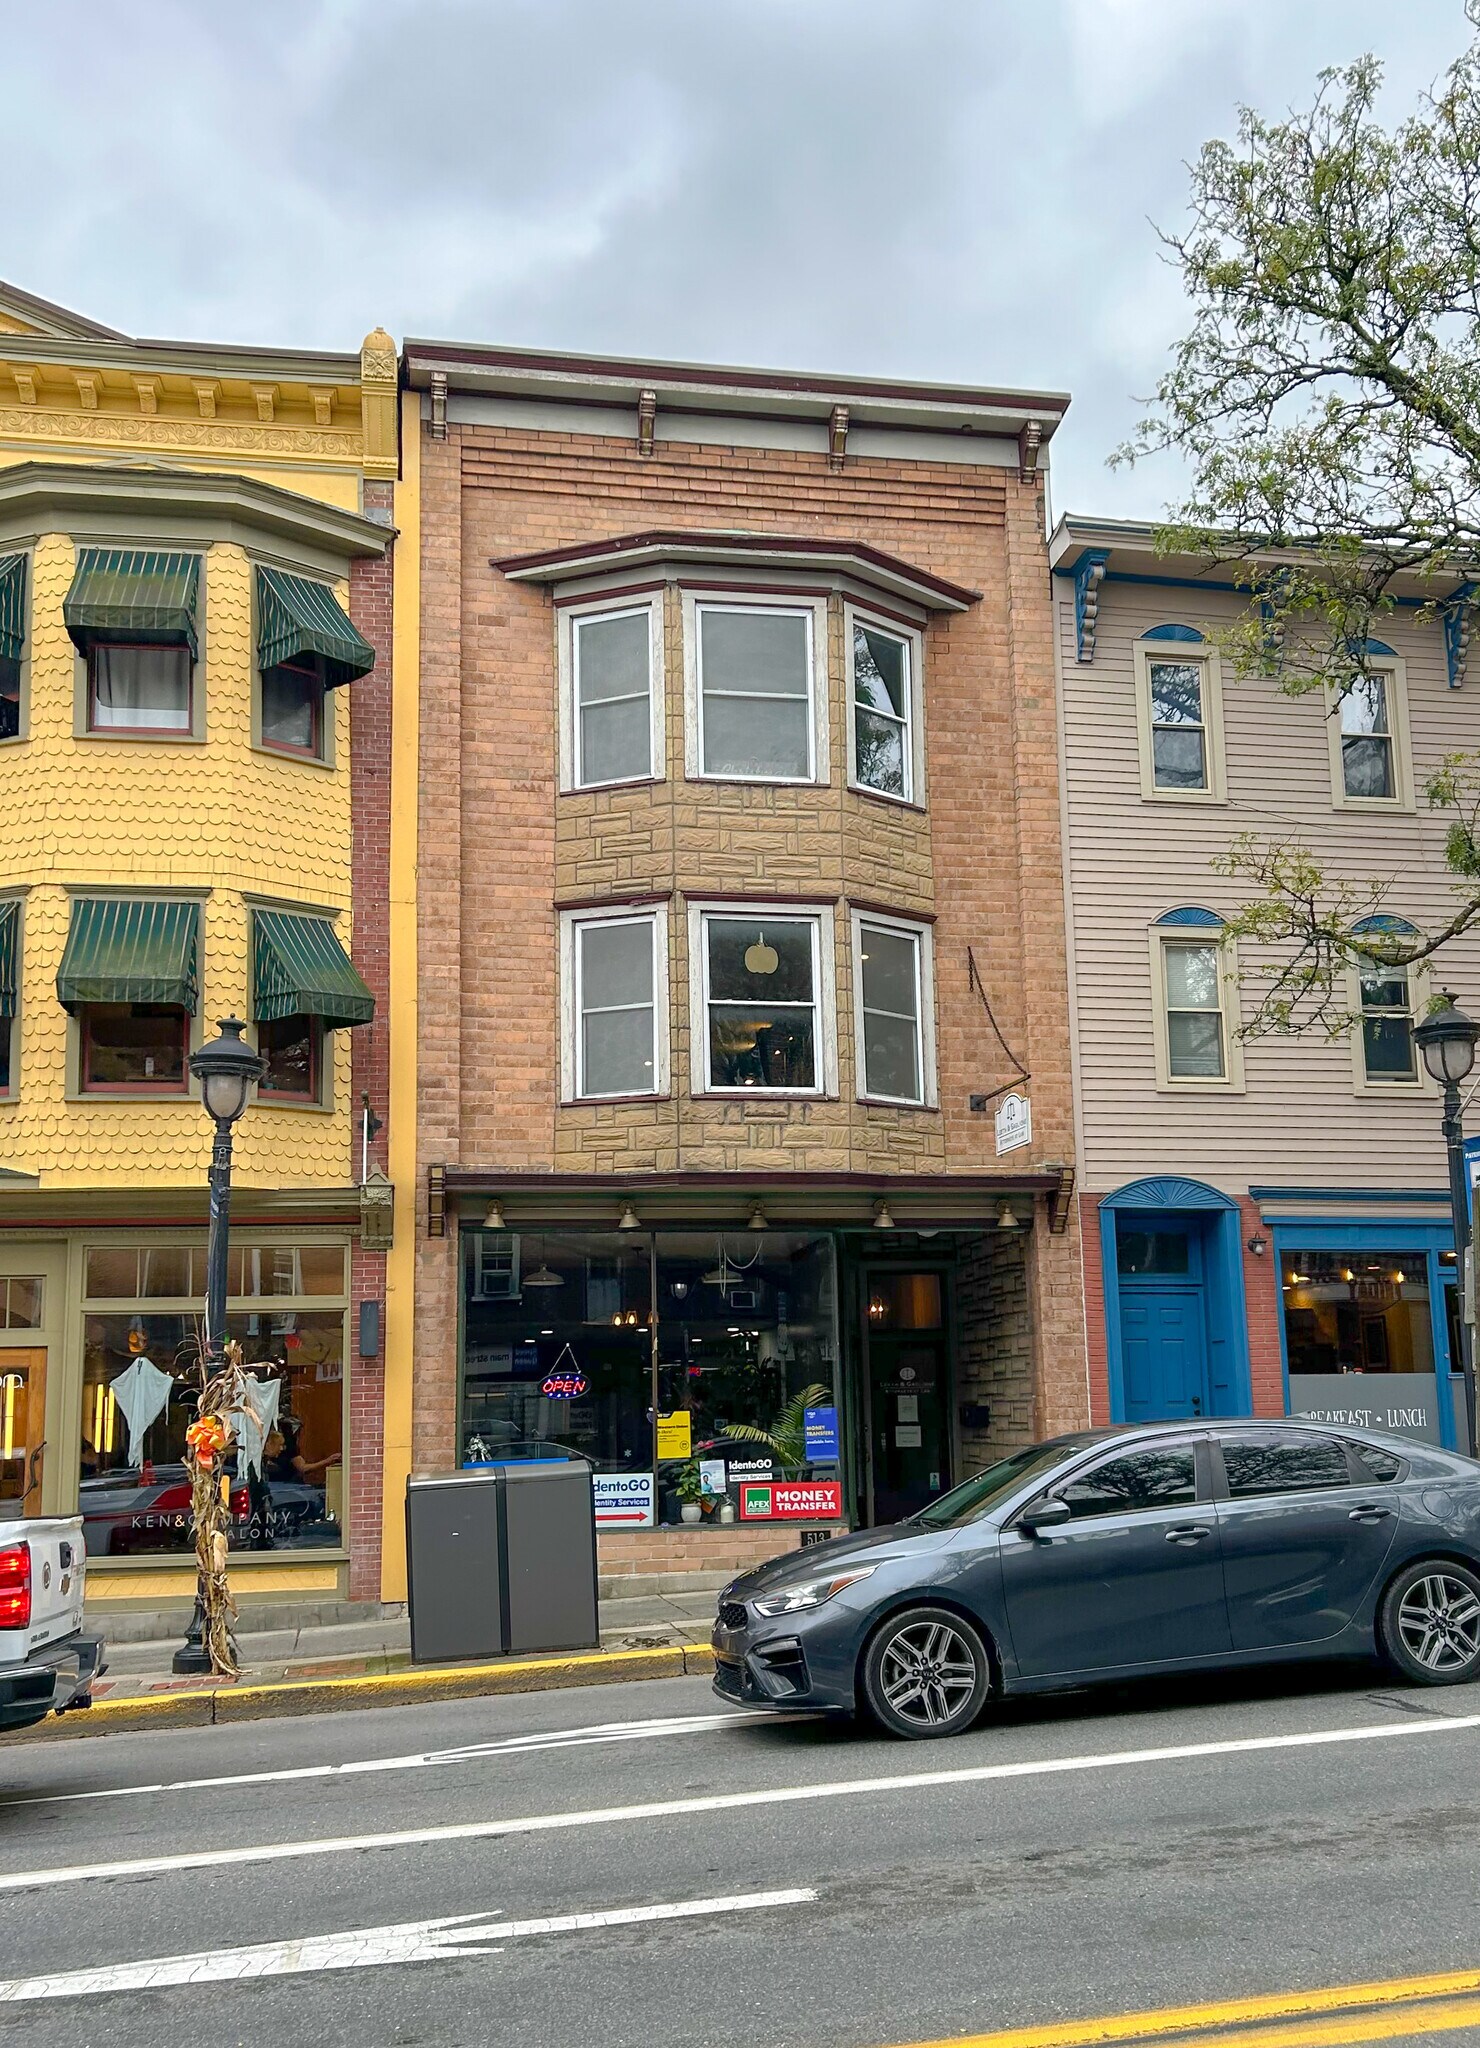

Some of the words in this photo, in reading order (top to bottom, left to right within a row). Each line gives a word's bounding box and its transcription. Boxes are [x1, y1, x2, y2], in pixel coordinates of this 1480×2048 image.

[542, 1380, 586, 1393] OPEN
[1386, 1408, 1427, 1427] LUNCH
[728, 1459, 772, 1470] IdentoGO
[593, 1479, 650, 1492] dentoGO
[775, 1490, 835, 1502] MONEY
[594, 1499, 617, 1507] entity
[617, 1498, 649, 1506] Services
[747, 1500, 770, 1508] AFEX
[776, 1501, 836, 1511] TRANSFER
[227, 1528, 275, 1540] ALON
